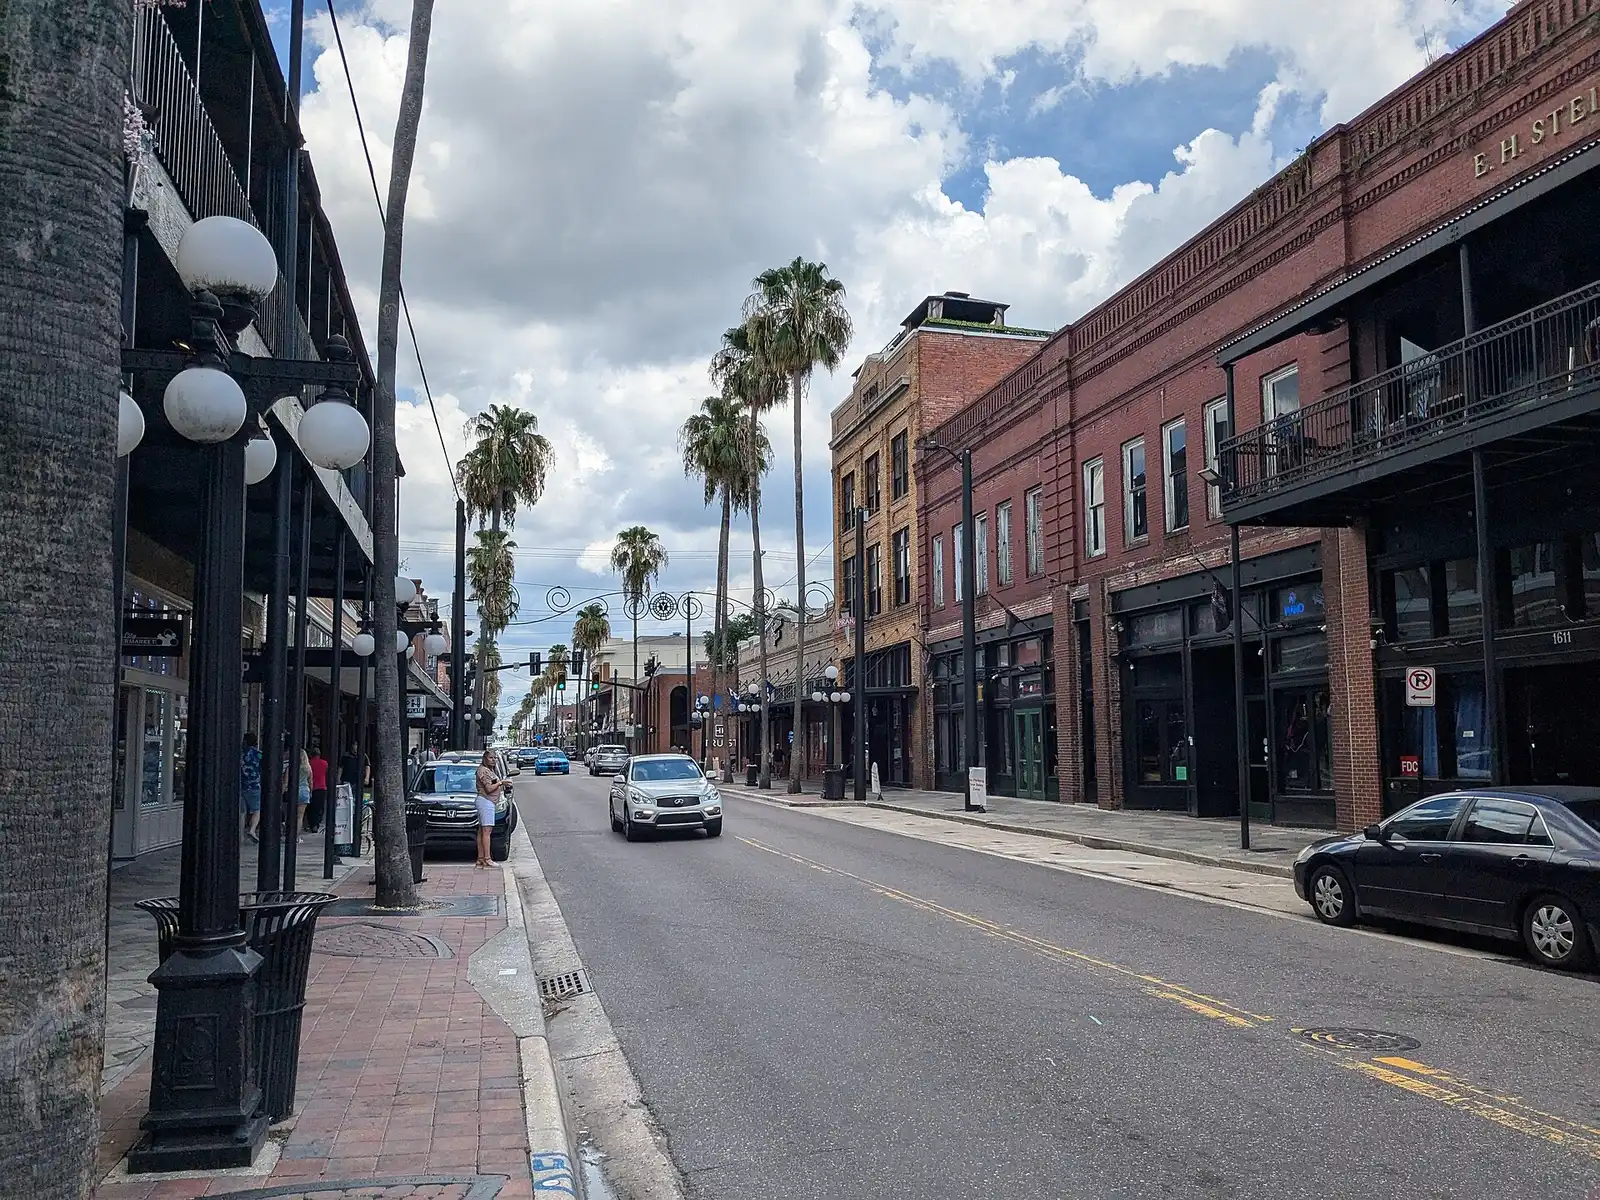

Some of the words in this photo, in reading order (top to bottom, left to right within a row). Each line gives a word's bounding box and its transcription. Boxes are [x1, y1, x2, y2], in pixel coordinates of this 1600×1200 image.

[1473, 152, 1495, 179] E.
[1500, 133, 1525, 165] H.
[1552, 630, 1572, 645] 1611
[1401, 760, 1419, 773] FDC
